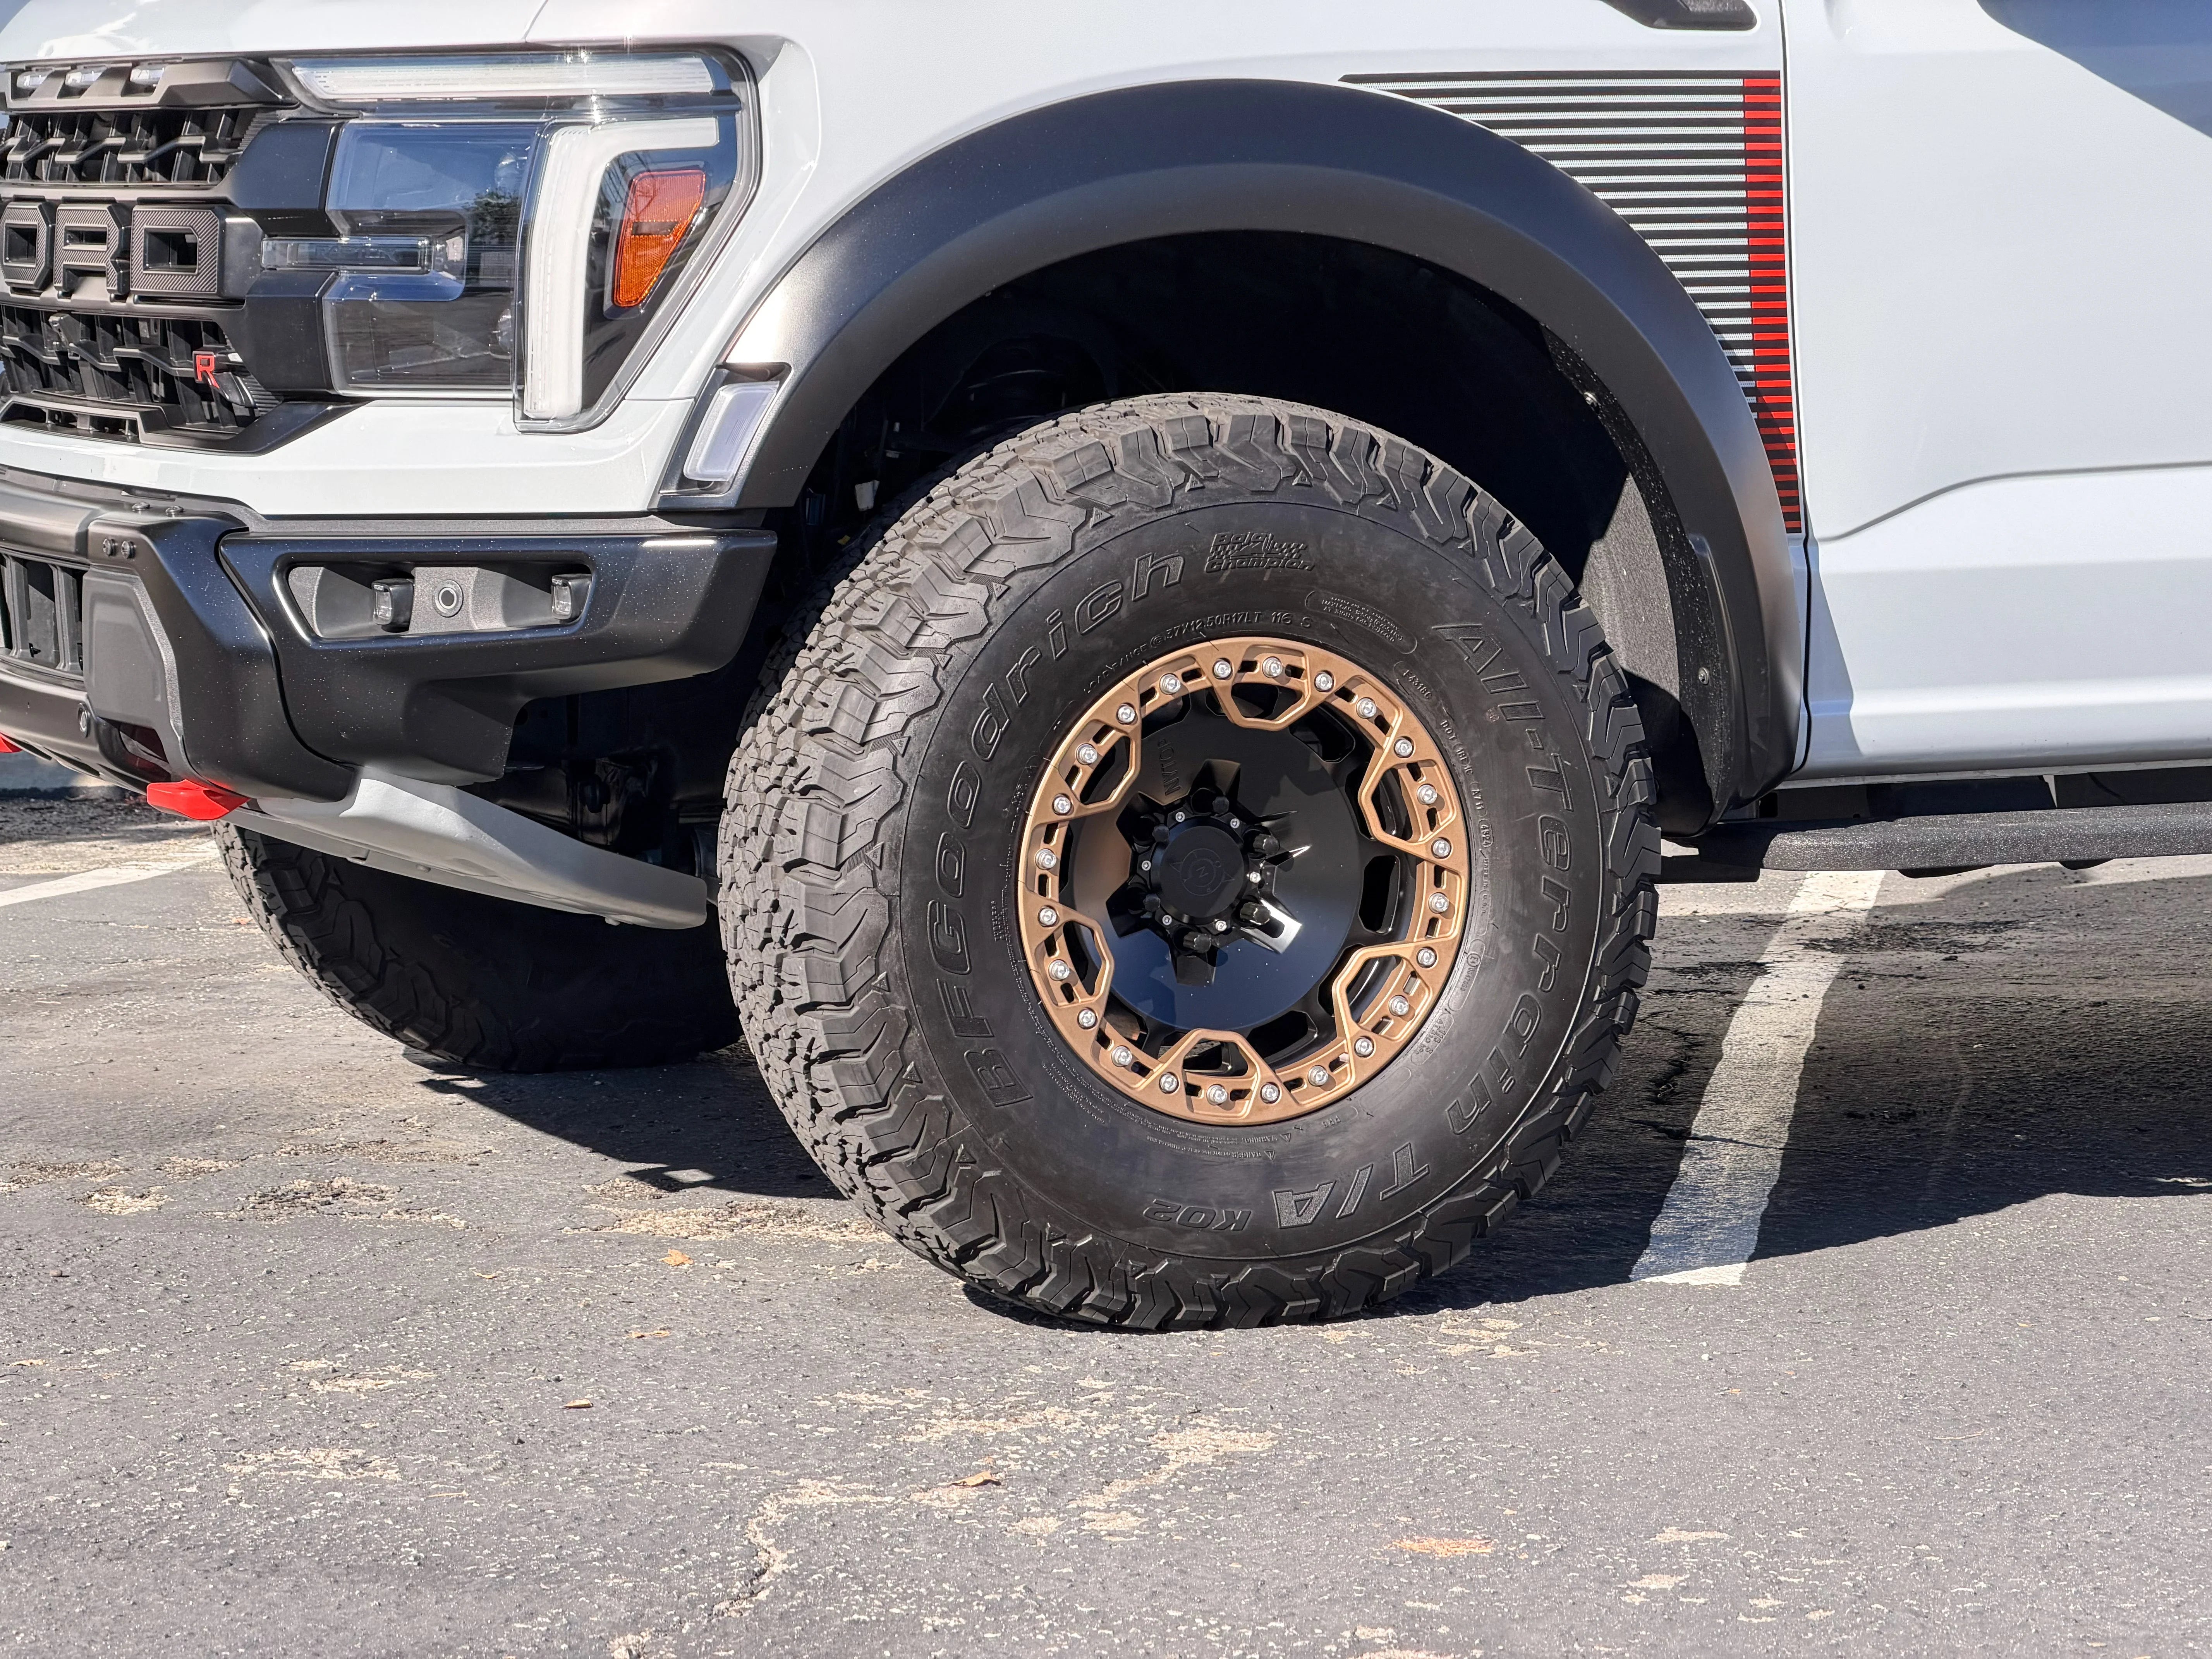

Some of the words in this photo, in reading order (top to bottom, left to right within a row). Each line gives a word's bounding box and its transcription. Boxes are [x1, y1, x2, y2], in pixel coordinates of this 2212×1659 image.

[196, 354, 220, 389] R
[1212, 532, 1269, 546] Baja
[1204, 557, 1316, 574] Champion
[1270, 611, 1293, 625] 116
[1299, 615, 1313, 629] S
[1440, 720, 1457, 740] DOT
[927, 552, 1185, 1107] BFGoodrich
[1432, 623, 1574, 1135] All-Terrain
[1483, 880, 1489, 888] IN
[1433, 1028, 1446, 1044] 116
[1272, 1142, 1431, 1230] T/A
